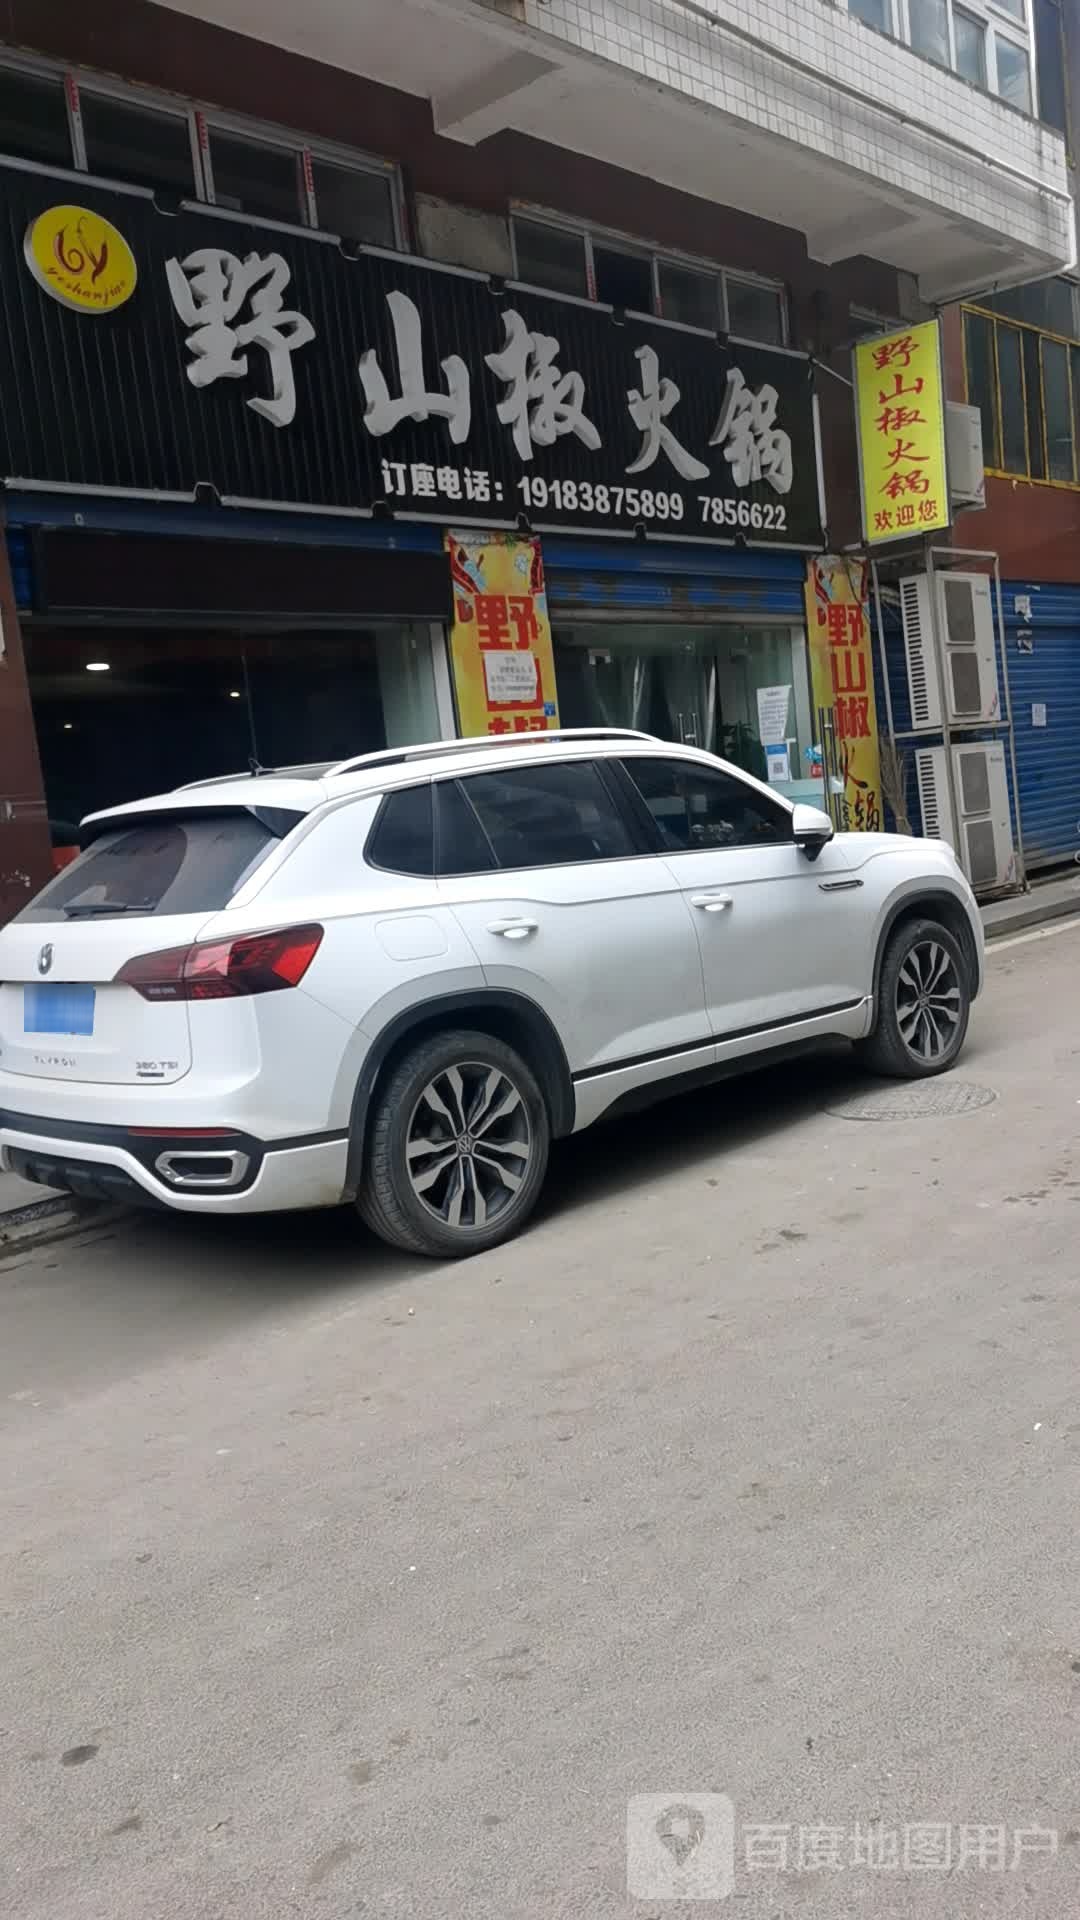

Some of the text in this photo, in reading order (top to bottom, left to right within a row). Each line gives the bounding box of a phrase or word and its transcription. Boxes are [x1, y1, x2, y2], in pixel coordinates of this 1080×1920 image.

[164, 248, 792, 495] 野山椒火锅
[872, 335, 929, 499] 野山椒火锅
[517, 476, 684, 520] 19183875899
[698, 496, 787, 531] 7856622
[874, 500, 938, 531] 欢迎您
